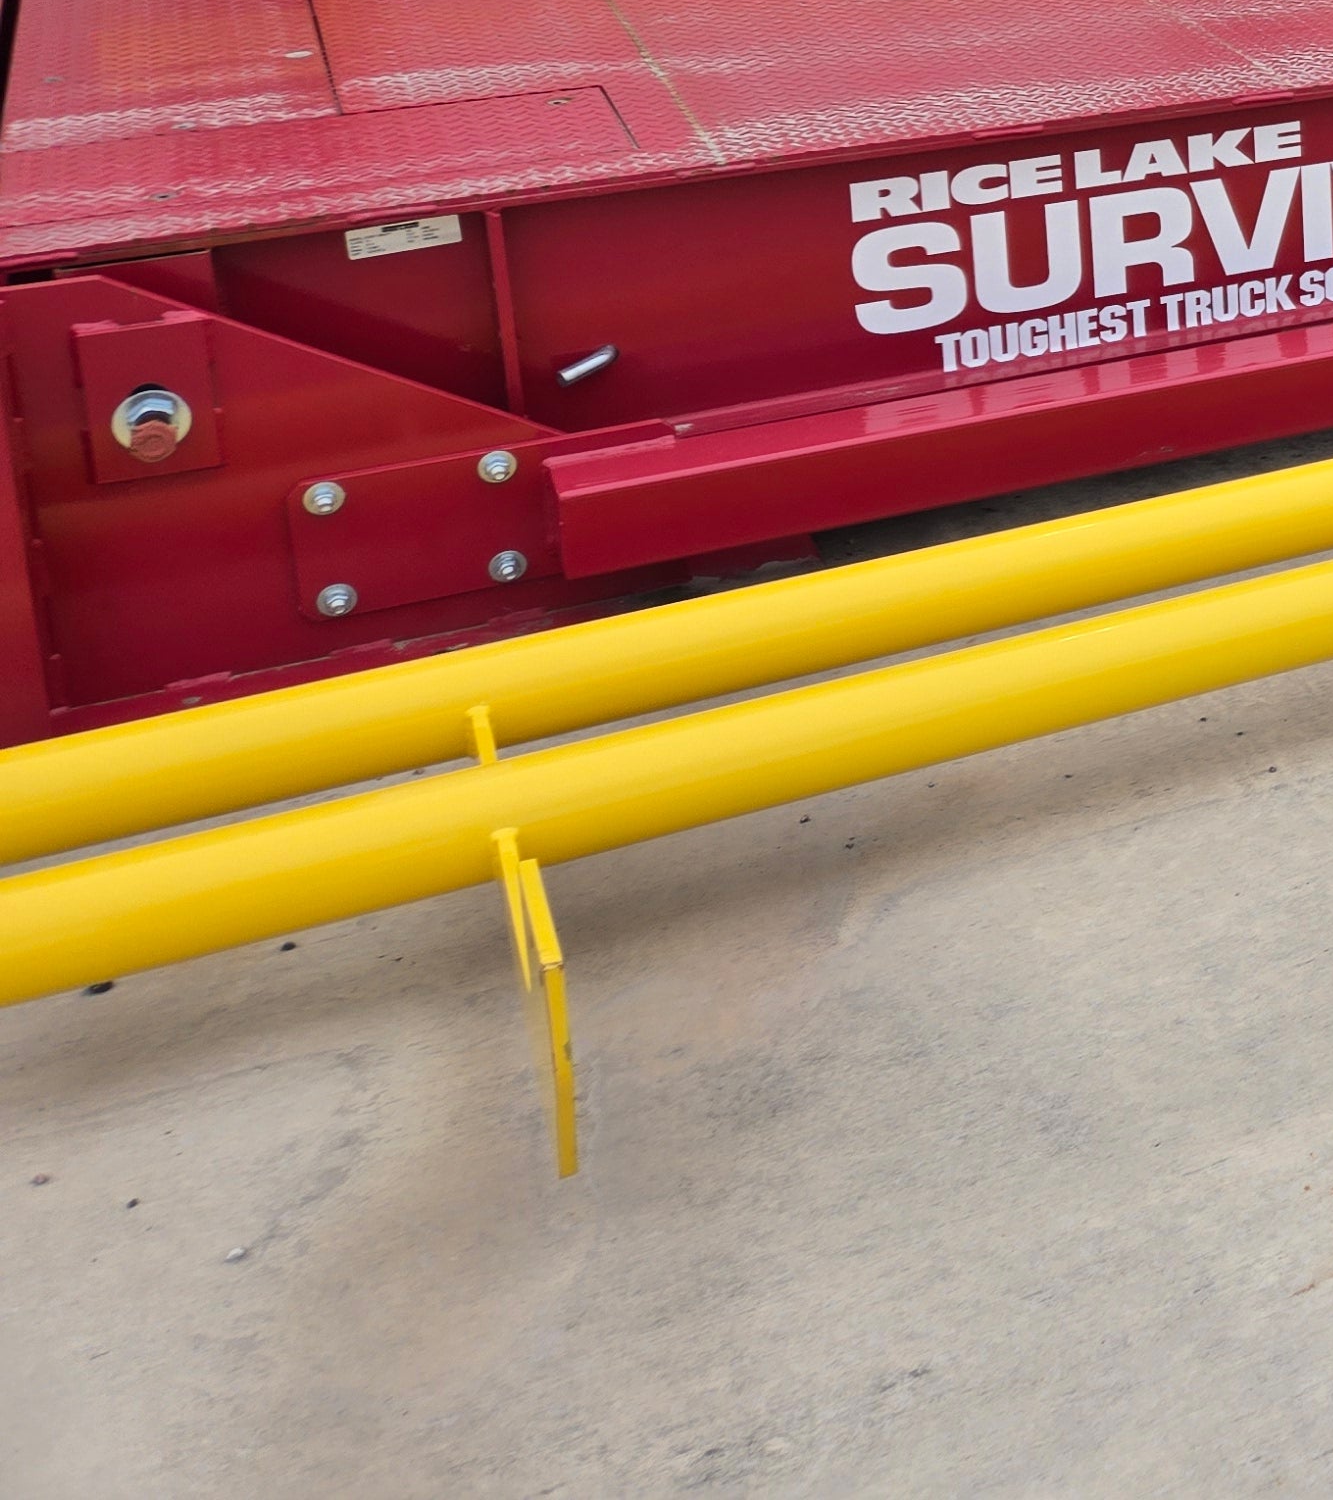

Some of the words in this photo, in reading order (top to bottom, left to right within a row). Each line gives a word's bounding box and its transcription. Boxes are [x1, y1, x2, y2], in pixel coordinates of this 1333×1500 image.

[849, 154, 1063, 223] RICE
[1073, 120, 1302, 190] LAKE
[935, 299, 1152, 373] TOUGHEST
[1160, 274, 1297, 332] TRUCK
